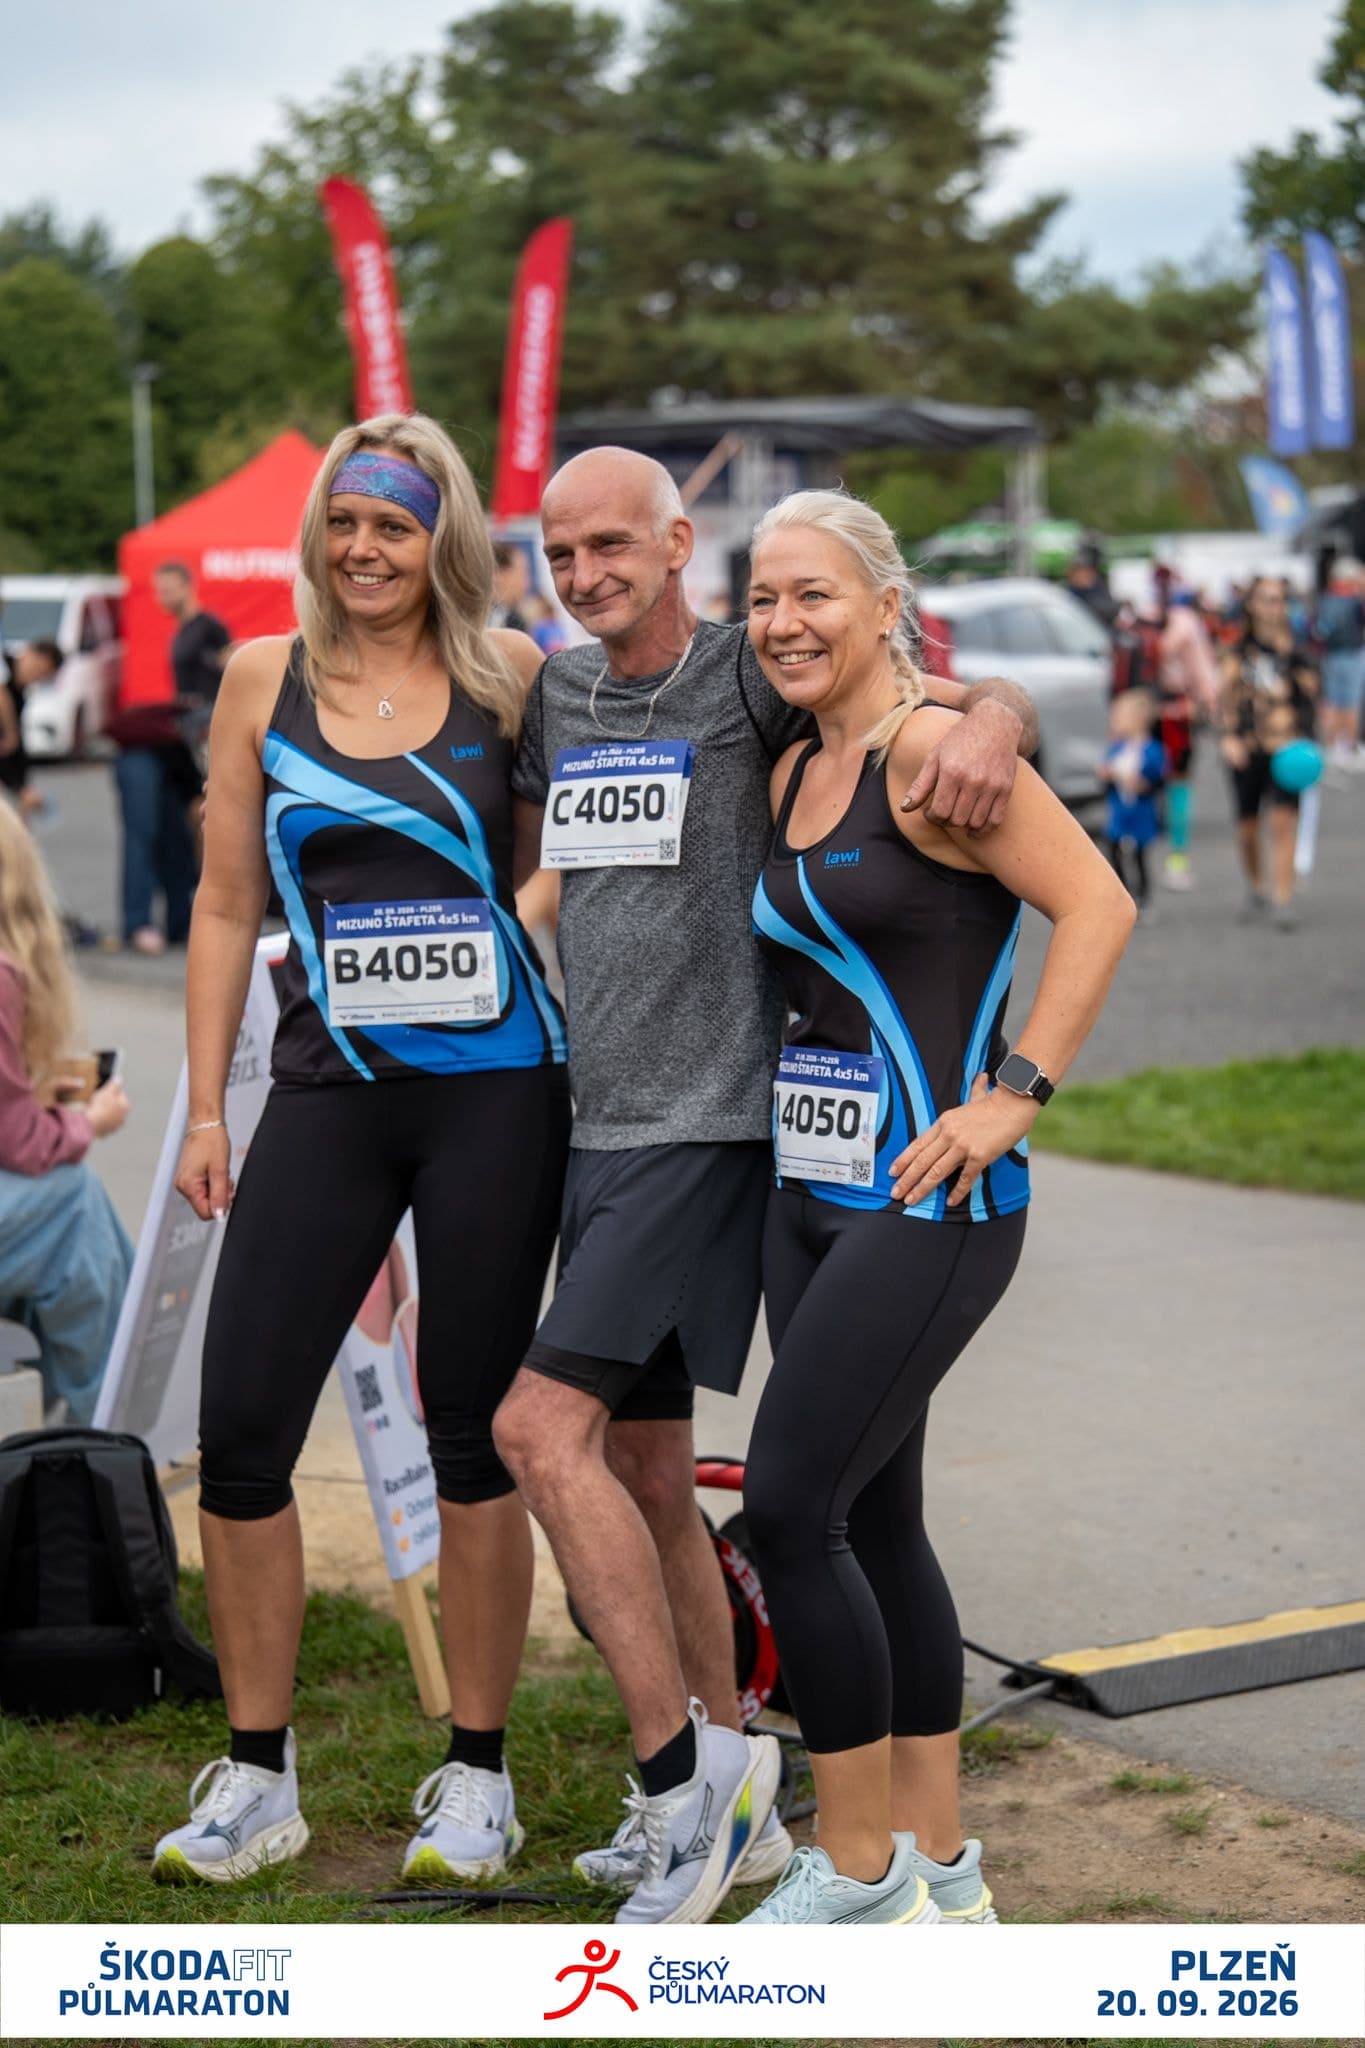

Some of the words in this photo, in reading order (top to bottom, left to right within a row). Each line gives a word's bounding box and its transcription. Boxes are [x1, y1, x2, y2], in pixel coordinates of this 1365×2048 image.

[562, 759, 595, 774] MIZUNO
[596, 756, 637, 769] ŠTAFETA
[638, 755, 658, 767] 4x5
[658, 753, 676, 766] km
[552, 783, 665, 826] C4050
[825, 847, 860, 865] lawi
[336, 917, 382, 932] MIZUNO
[384, 913, 436, 929] ŠTAFETA
[438, 913, 459, 926] 4x5
[461, 911, 480, 925] km
[334, 942, 477, 984] B4050
[797, 1061, 832, 1078] ŠTAFETA
[833, 1067, 852, 1081] 4x5
[853, 1068, 869, 1083] km
[776, 1091, 861, 1140] 4050
